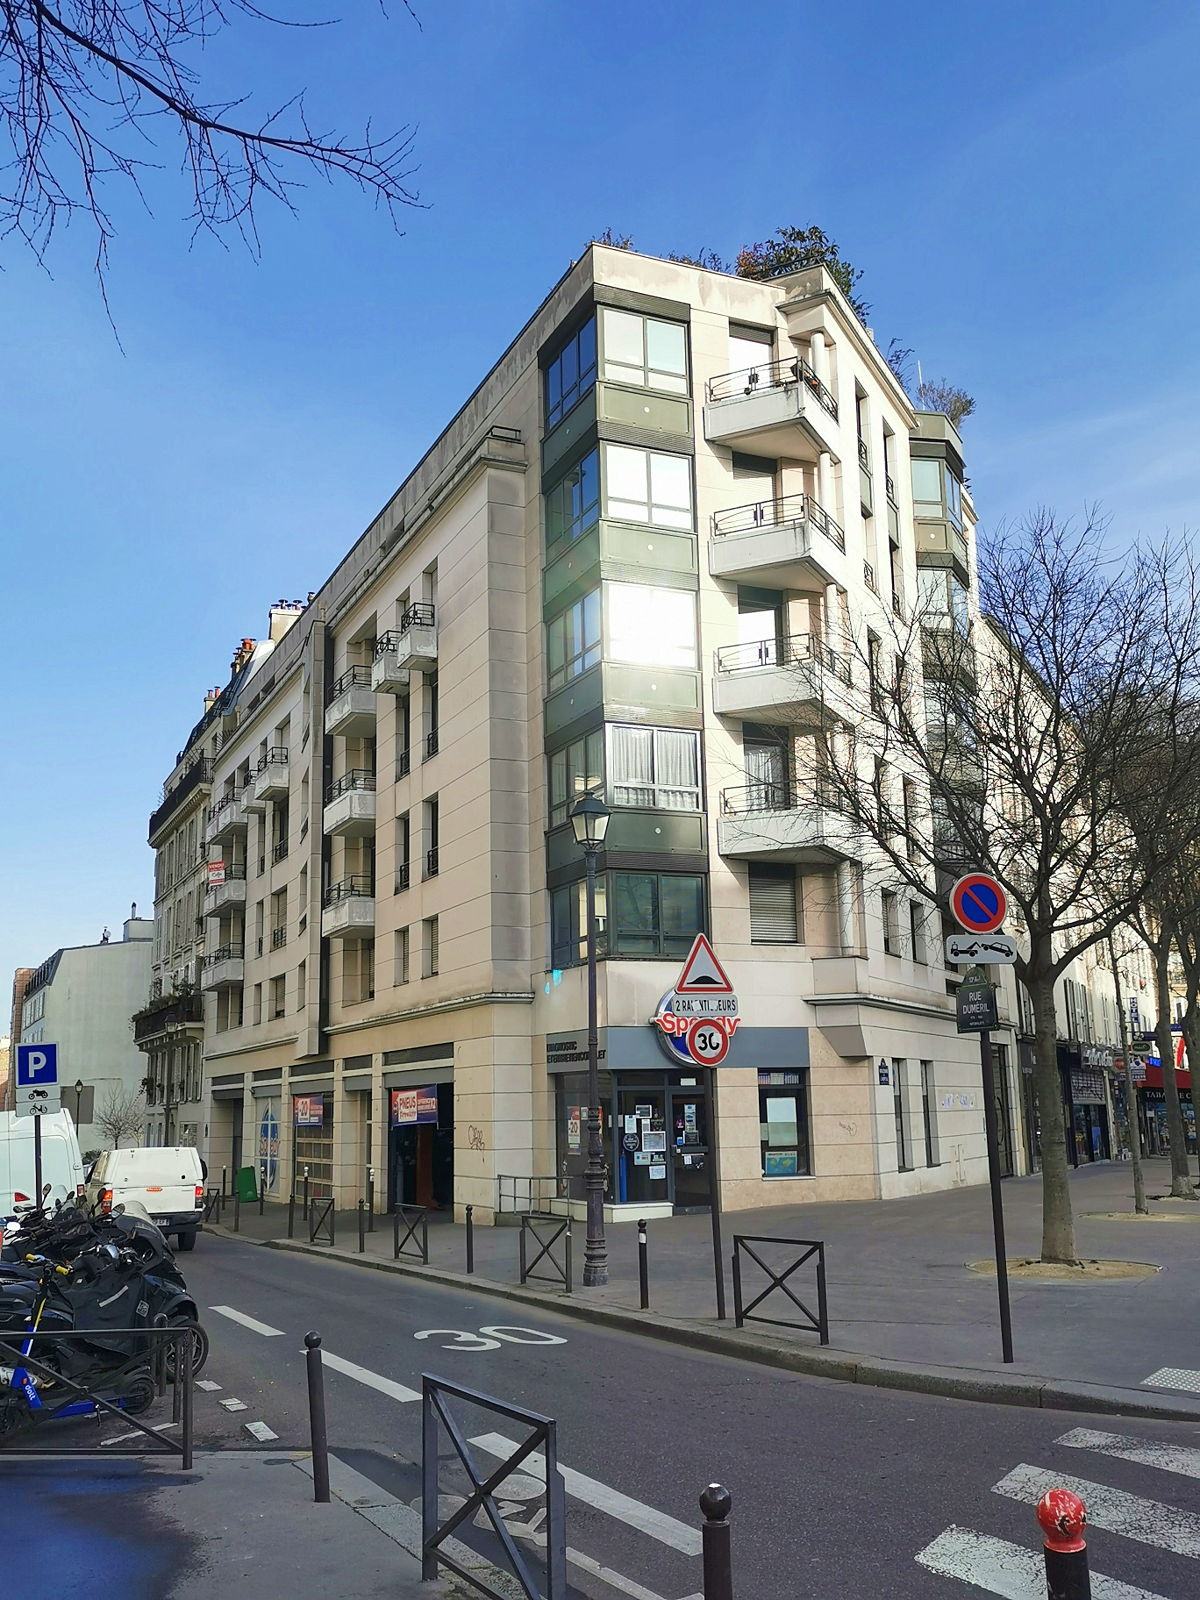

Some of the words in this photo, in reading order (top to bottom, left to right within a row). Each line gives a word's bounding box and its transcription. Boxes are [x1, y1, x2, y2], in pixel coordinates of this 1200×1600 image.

[968, 991, 982, 1002] RUE
[675, 1000, 681, 1011] 2
[962, 1001, 990, 1014] DUMÉRIL
[698, 1033, 720, 1051] 30
[28, 1051, 47, 1078] P
[413, 1325, 568, 1352] 30
